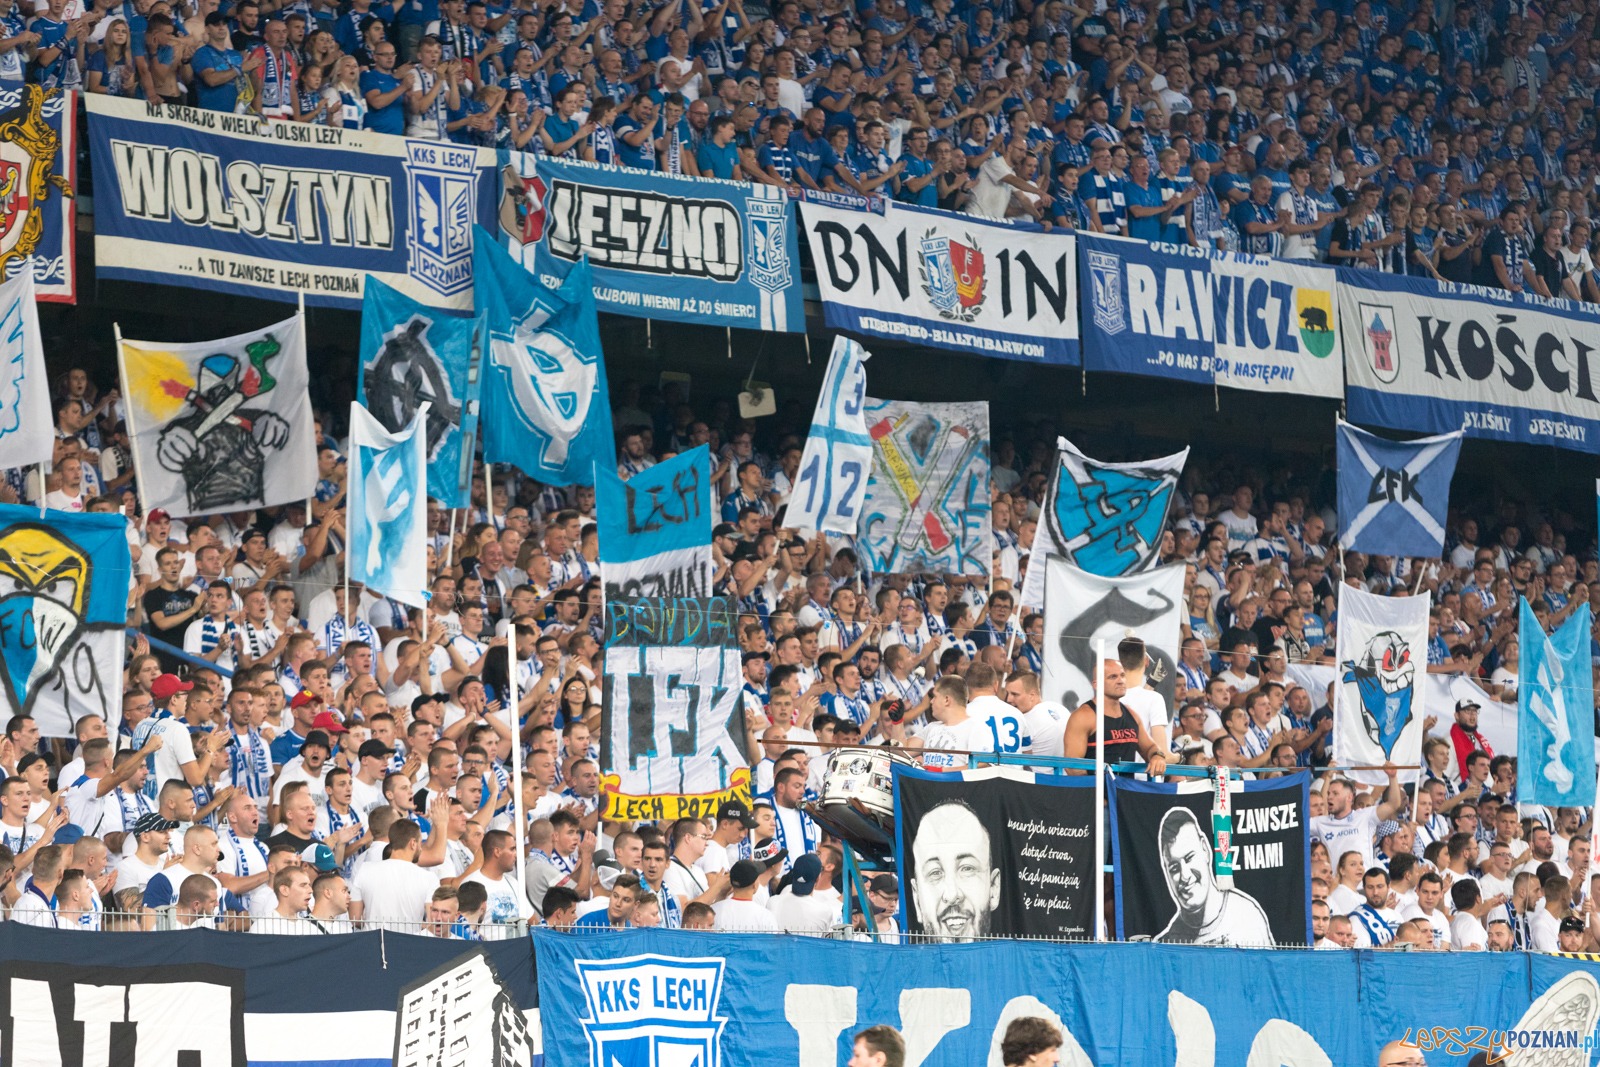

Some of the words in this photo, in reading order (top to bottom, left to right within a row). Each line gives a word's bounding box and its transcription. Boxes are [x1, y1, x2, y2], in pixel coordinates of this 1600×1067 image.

[145, 101, 163, 118] NA
[167, 105, 215, 128] SKRAJU
[220, 115, 311, 142] WIELKOLSKI
[413, 146, 436, 164] KKS
[442, 148, 471, 168] LECH
[110, 138, 395, 250] WOLSZTYN
[806, 189, 866, 206] GNIEZNO
[751, 203, 764, 214] KKS
[551, 182, 742, 281] LESZNO
[198, 257, 206, 273] A
[209, 258, 224, 276] TU
[229, 262, 275, 284] ZAWSZE
[280, 270, 310, 289] LECH
[314, 274, 359, 293] POZNAŃ
[423, 260, 472, 283] POZNAŃ
[643, 294, 680, 311] WIERNI
[682, 298, 696, 313] AŻ
[699, 301, 712, 314] DO
[714, 300, 756, 318] ŚMIERCI
[1126, 262, 1299, 353] RAWICZ
[1437, 280, 1457, 293] NA
[1461, 282, 1514, 302] ZAWSZE
[1523, 291, 1571, 311] WIERNI
[1177, 353, 1198, 370] NAS
[1234, 361, 1294, 384] NASTĘPNI
[985, 716, 1020, 753] 13
[1110, 728, 1138, 739] BOSS
[612, 797, 663, 819] LECH
[1235, 802, 1299, 834] ZAWSZE
[1337, 828, 1359, 837] AFORTI
[1021, 843, 1048, 861] dotąd
[1243, 842, 1284, 870] NAMI
[1018, 867, 1041, 885] okąd
[1033, 894, 1047, 907] im
[596, 980, 639, 1013] KKS
[652, 976, 707, 1012] LECH
